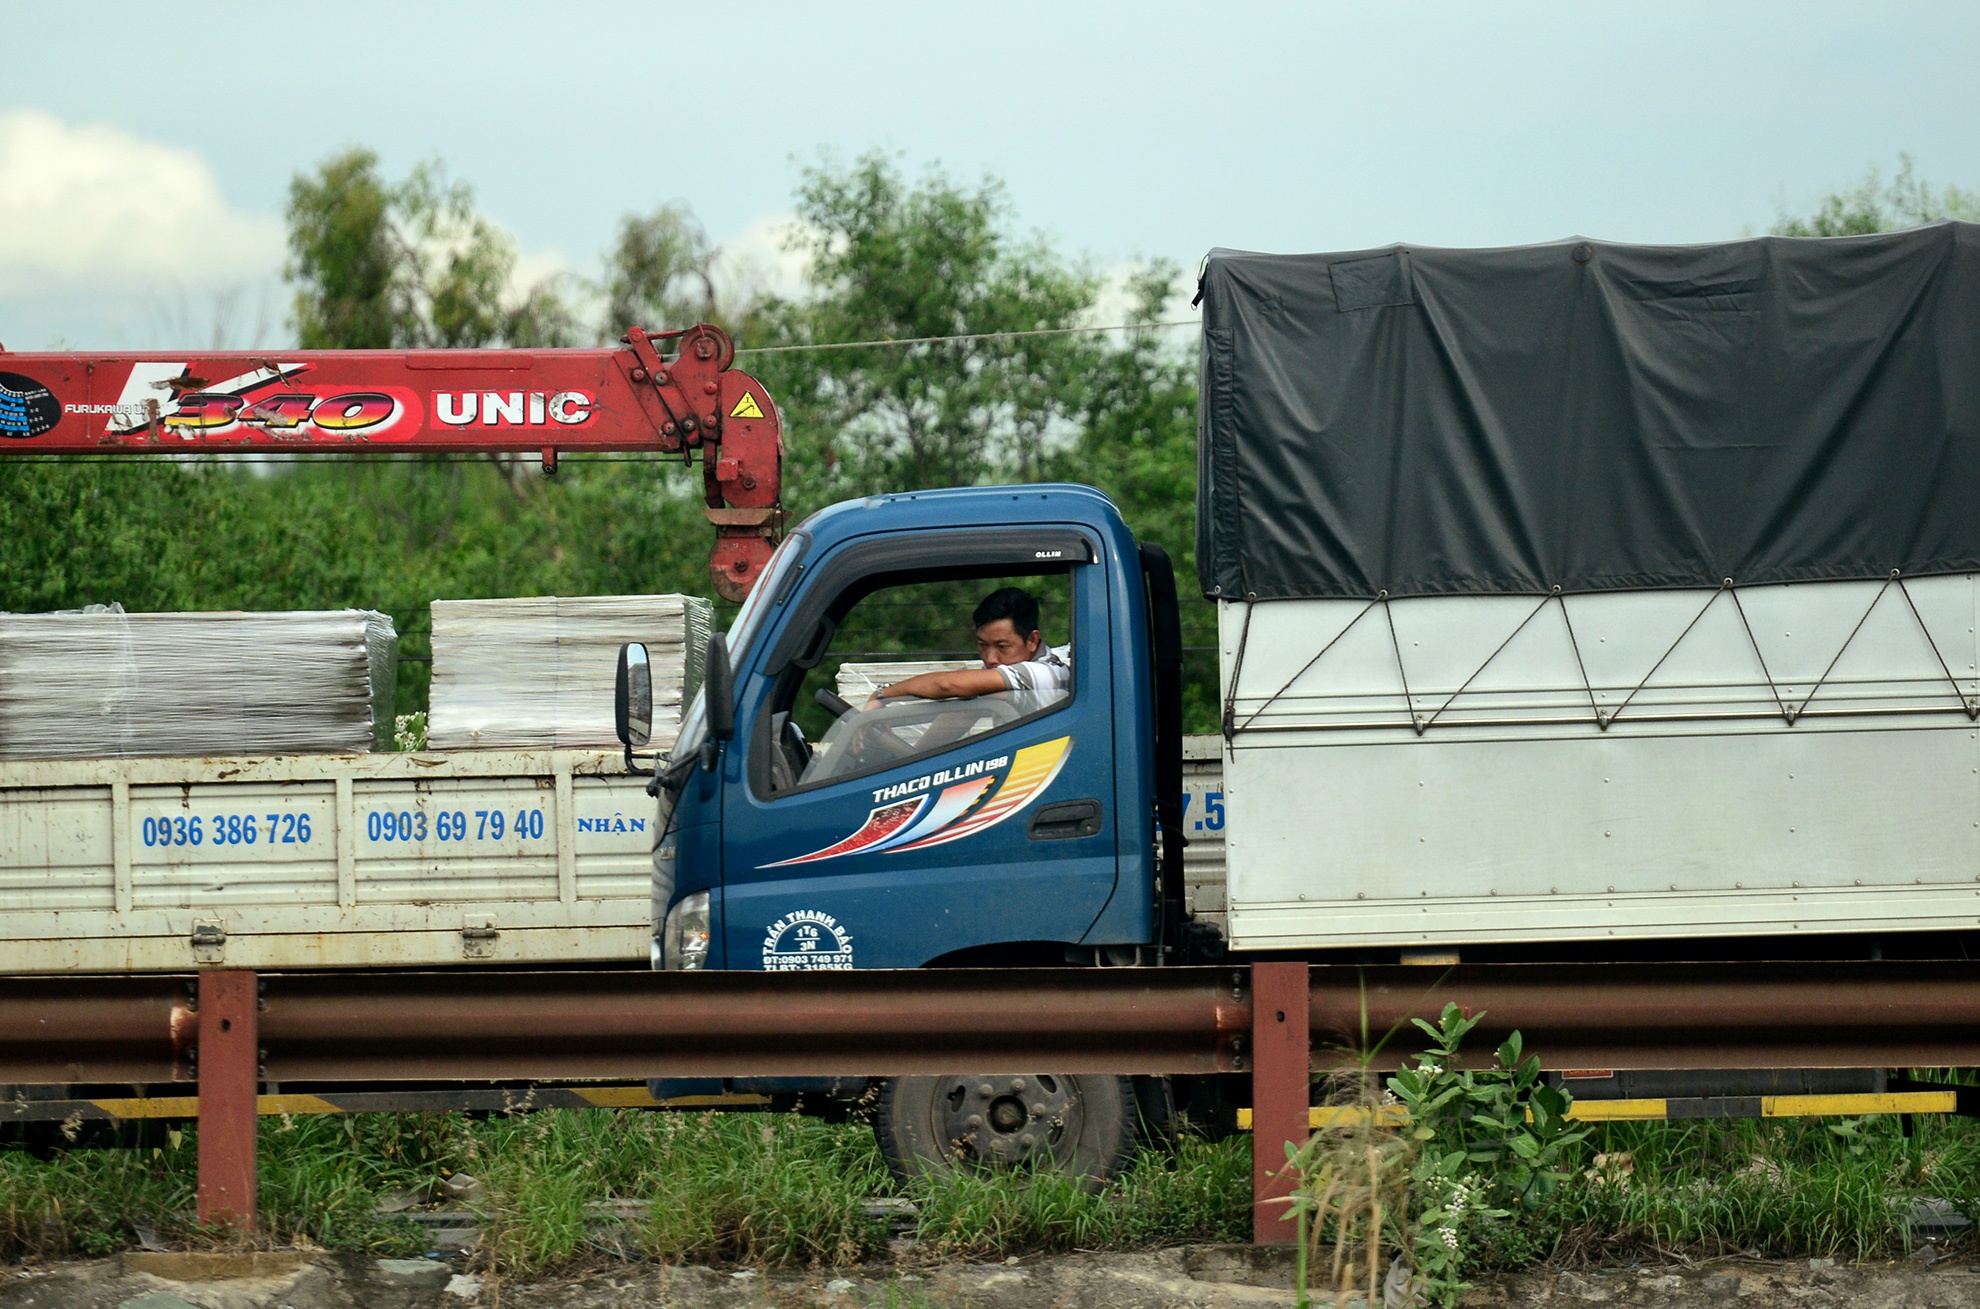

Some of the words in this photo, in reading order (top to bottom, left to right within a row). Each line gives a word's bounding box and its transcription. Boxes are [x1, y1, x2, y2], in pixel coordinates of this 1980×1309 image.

[64, 403, 132, 414] FURUKAWA
[436, 391, 591, 426] UNIC
[1035, 550, 1062, 558] OLLIN
[872, 775, 931, 803] THACO
[932, 760, 984, 786] OLLIN
[985, 756, 1009, 772] 198
[143, 816, 203, 847] 0936
[212, 814, 257, 845] 386
[266, 813, 312, 843] 726
[367, 811, 428, 842] 0903
[436, 811, 467, 841] 69
[475, 810, 505, 840] 79
[514, 809, 544, 840] 40
[577, 812, 646, 836] NHẬN
[786, 909, 836, 928] THANH
[810, 955, 831, 963] 749
[833, 955, 853, 963] 971
